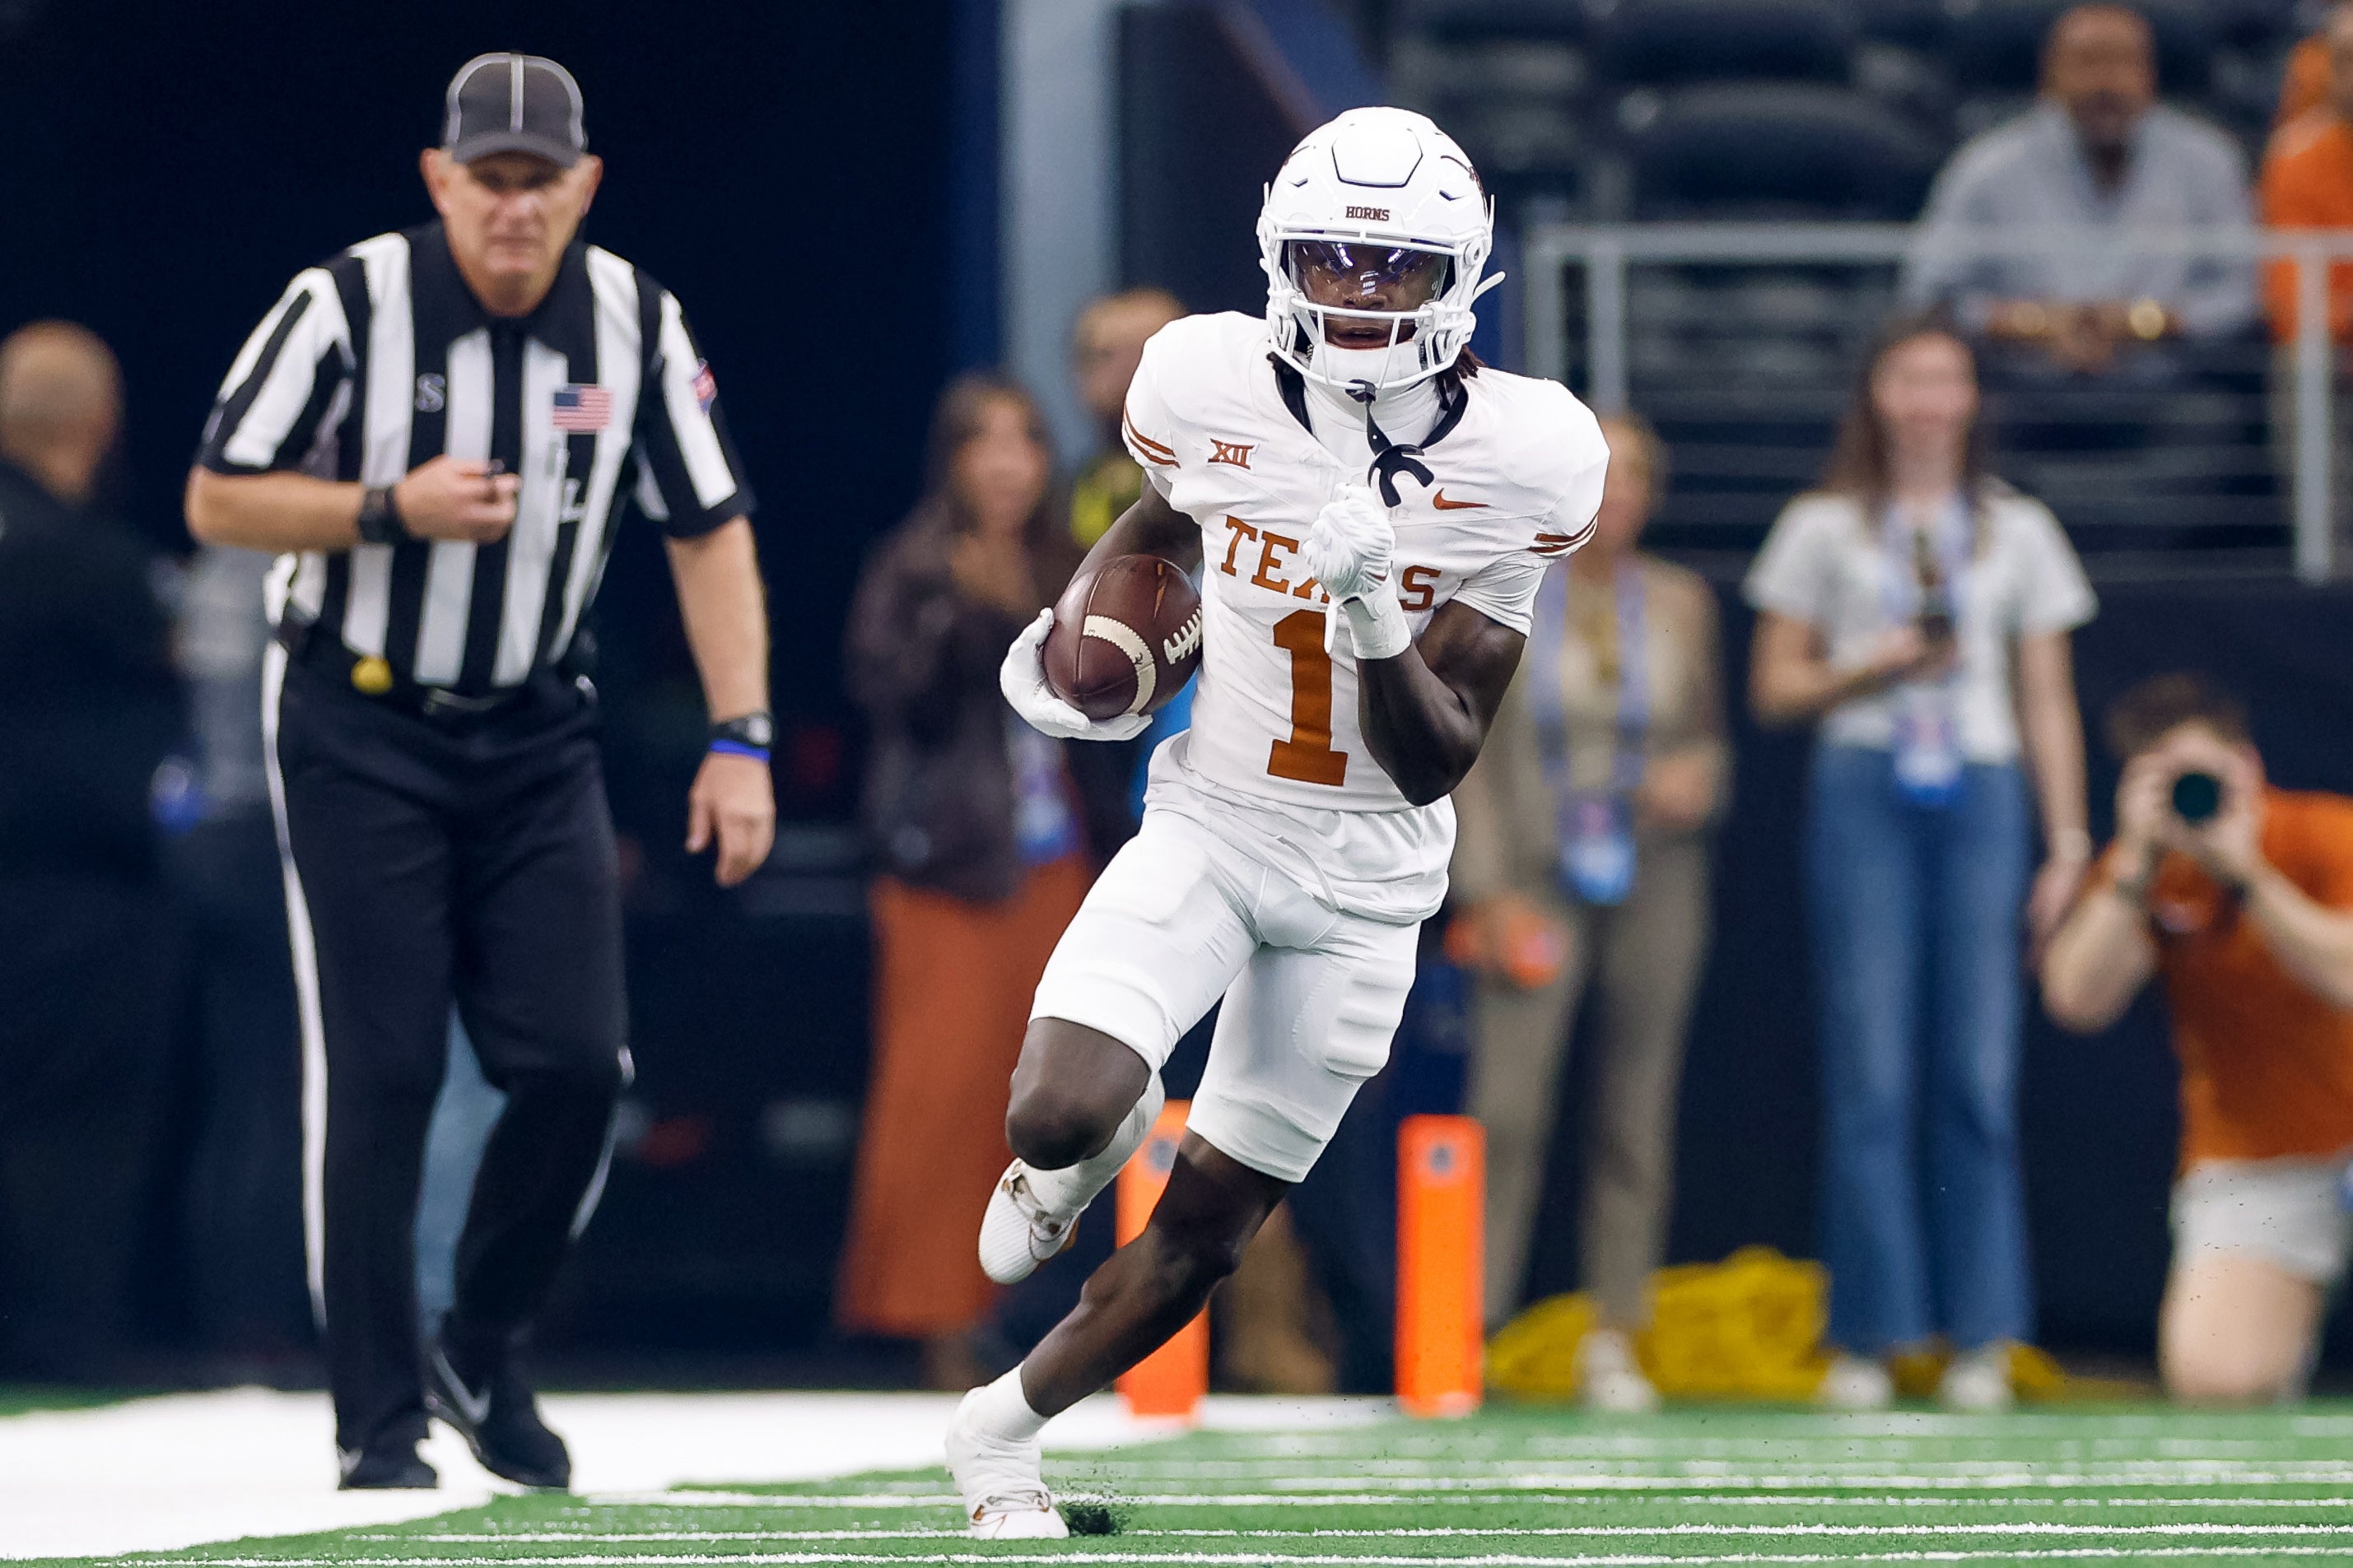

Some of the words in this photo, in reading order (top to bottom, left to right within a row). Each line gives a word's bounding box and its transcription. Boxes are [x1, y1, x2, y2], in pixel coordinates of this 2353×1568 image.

[1345, 206, 1390, 221] HORNS
[416, 372, 445, 412] S
[1208, 438, 1255, 470] XII
[1221, 514, 1442, 611] TES
[1267, 609, 1349, 787] 1
